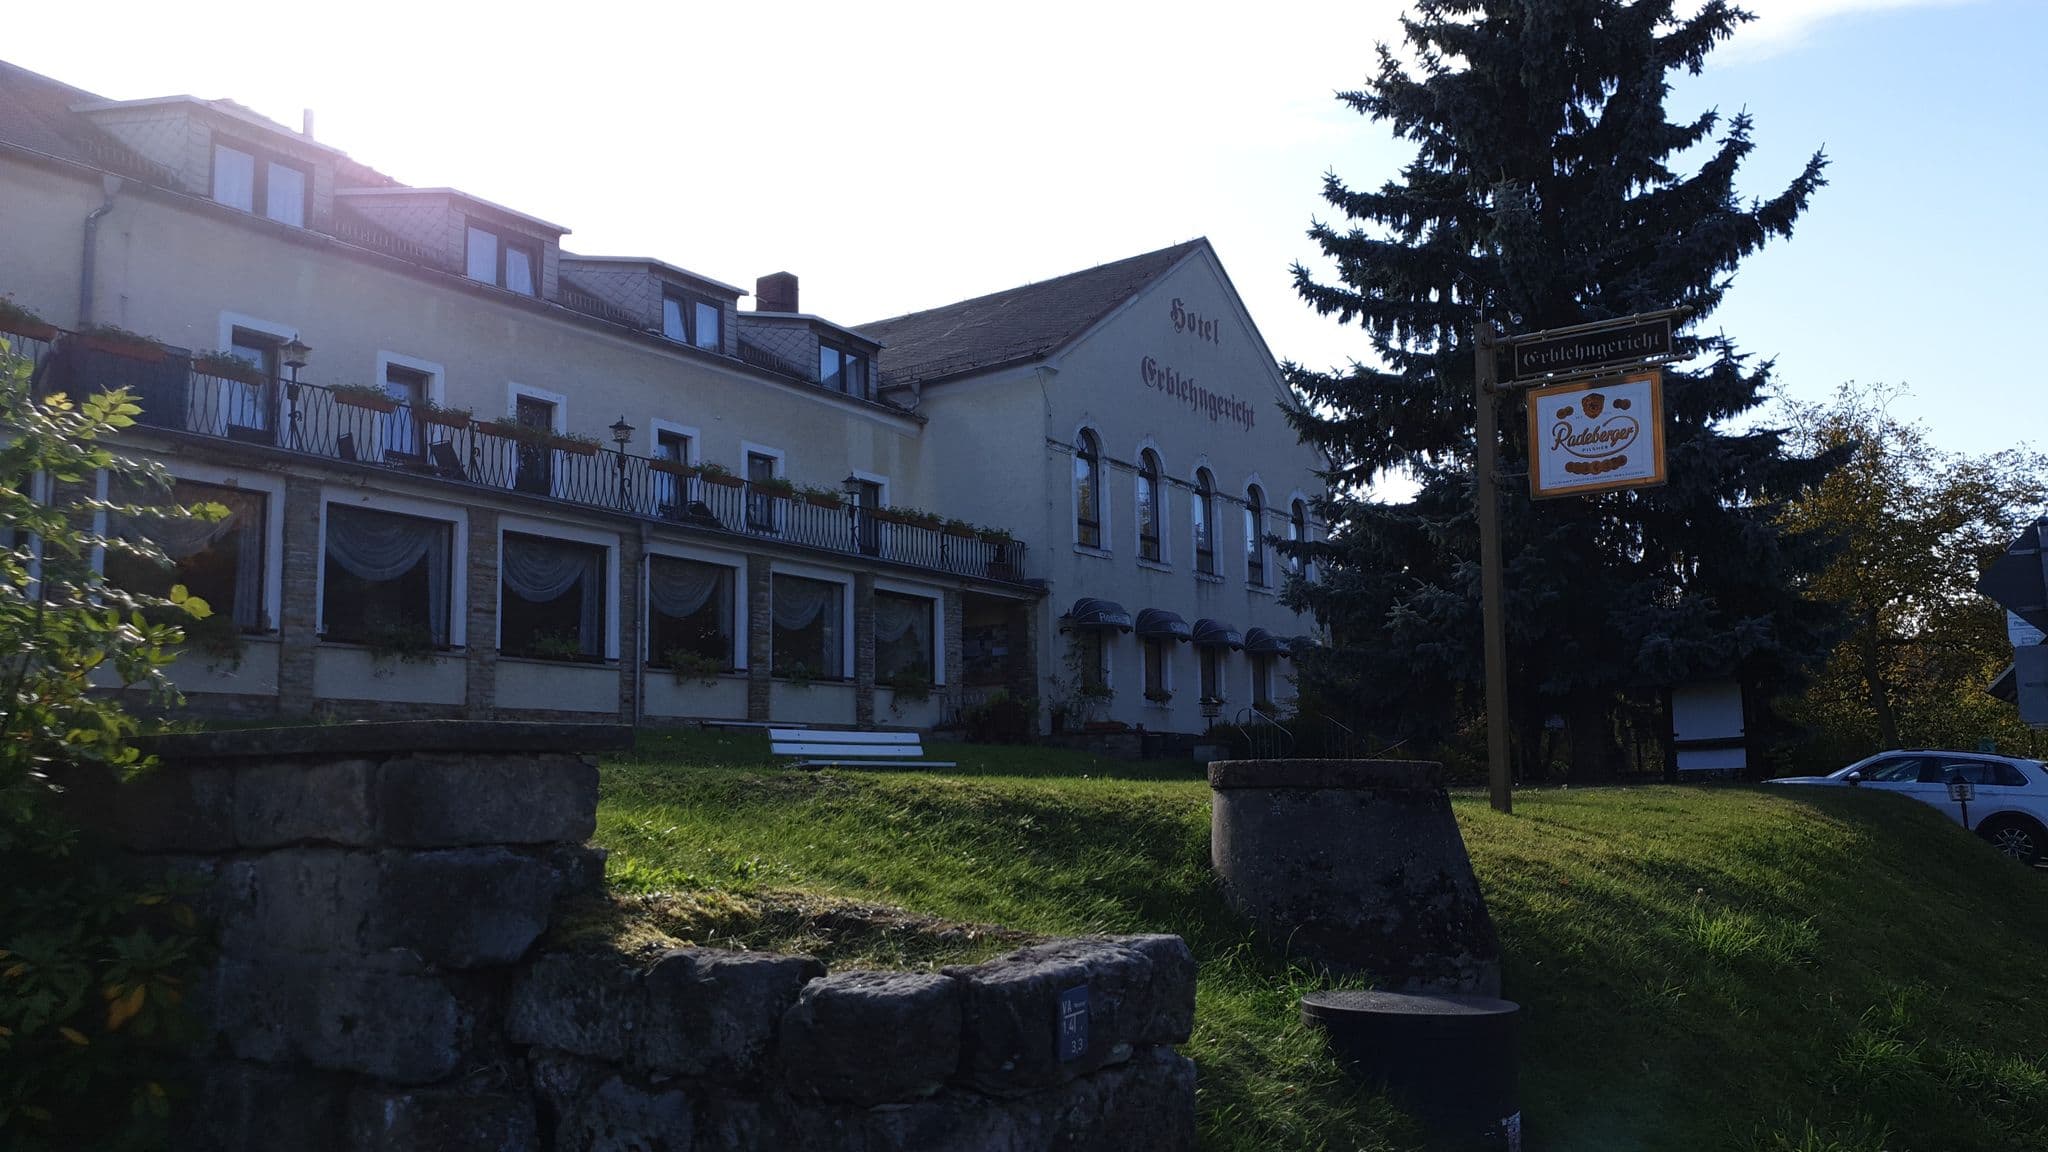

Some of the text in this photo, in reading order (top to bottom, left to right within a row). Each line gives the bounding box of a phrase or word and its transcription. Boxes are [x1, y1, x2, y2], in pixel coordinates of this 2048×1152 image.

[1170, 298, 1220, 346] Hotel
[1523, 332, 1661, 367] Erblehngericht
[1141, 356, 1255, 432] Erblehngericht
[1551, 419, 1636, 451] Radeberger
